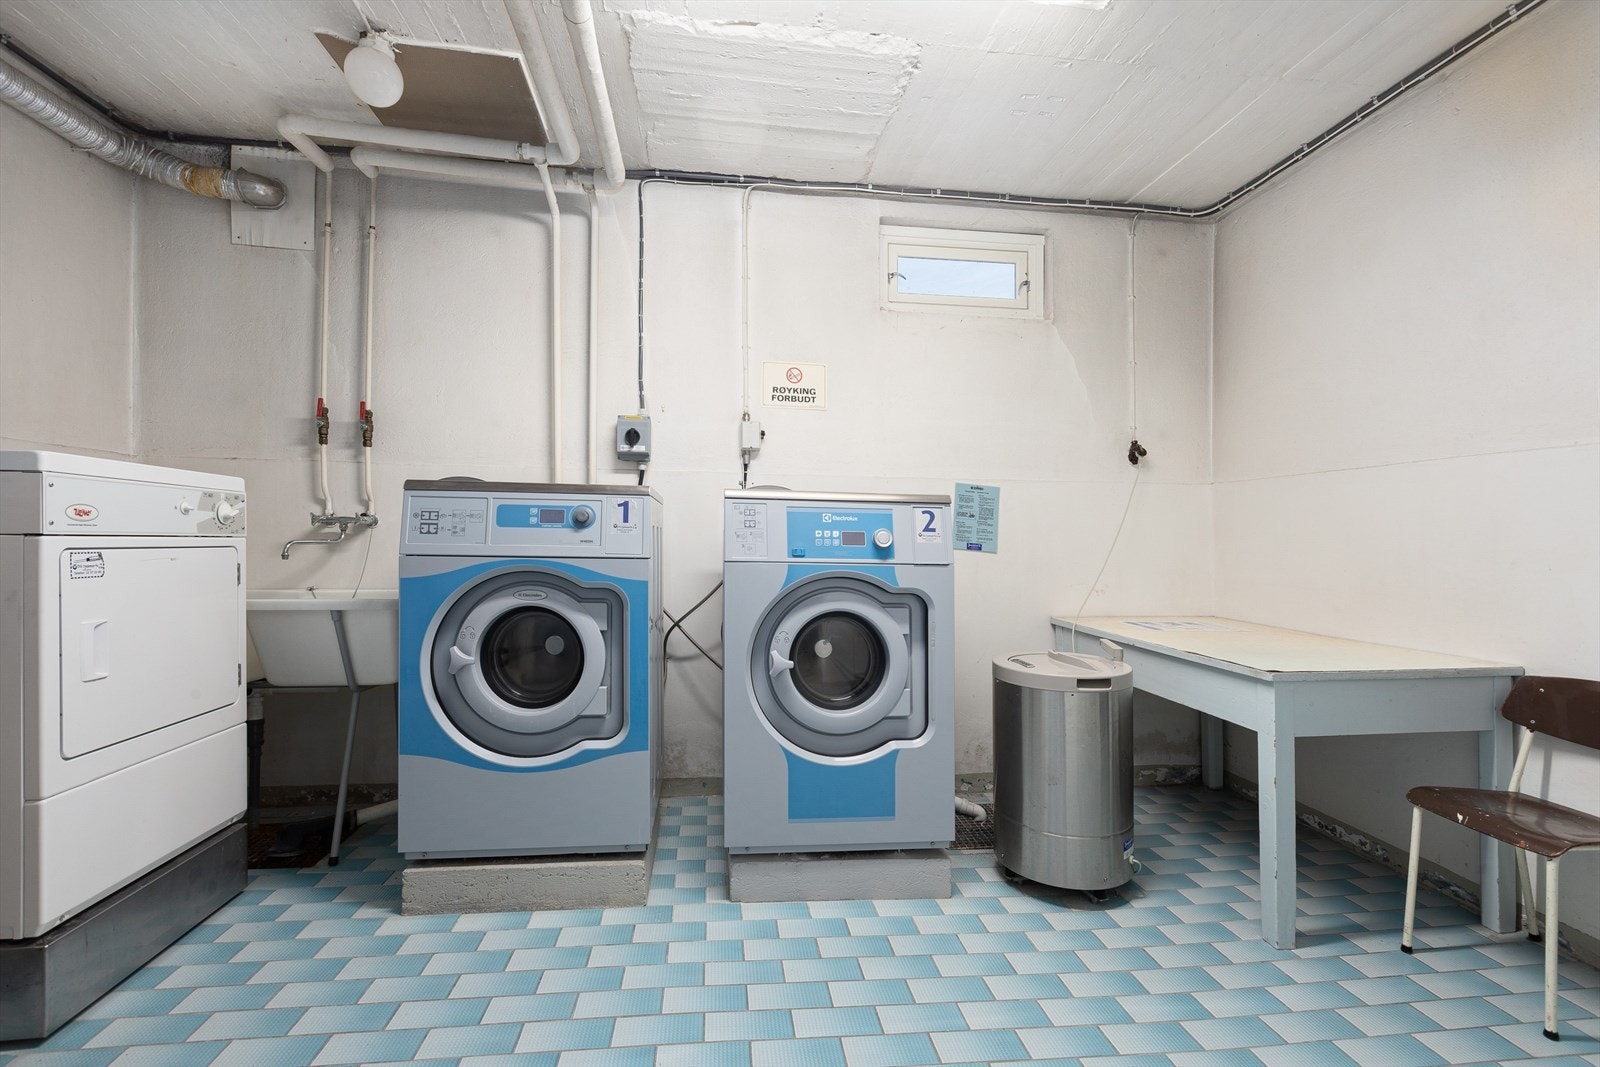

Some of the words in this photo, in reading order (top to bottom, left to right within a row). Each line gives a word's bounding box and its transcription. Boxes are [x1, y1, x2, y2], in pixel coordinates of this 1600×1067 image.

[772, 386, 817, 396] RØYKING
[771, 394, 817, 403] FORBUDT
[617, 500, 630, 524] 1
[832, 514, 858, 522] Electrolux
[921, 509, 937, 533] 2
